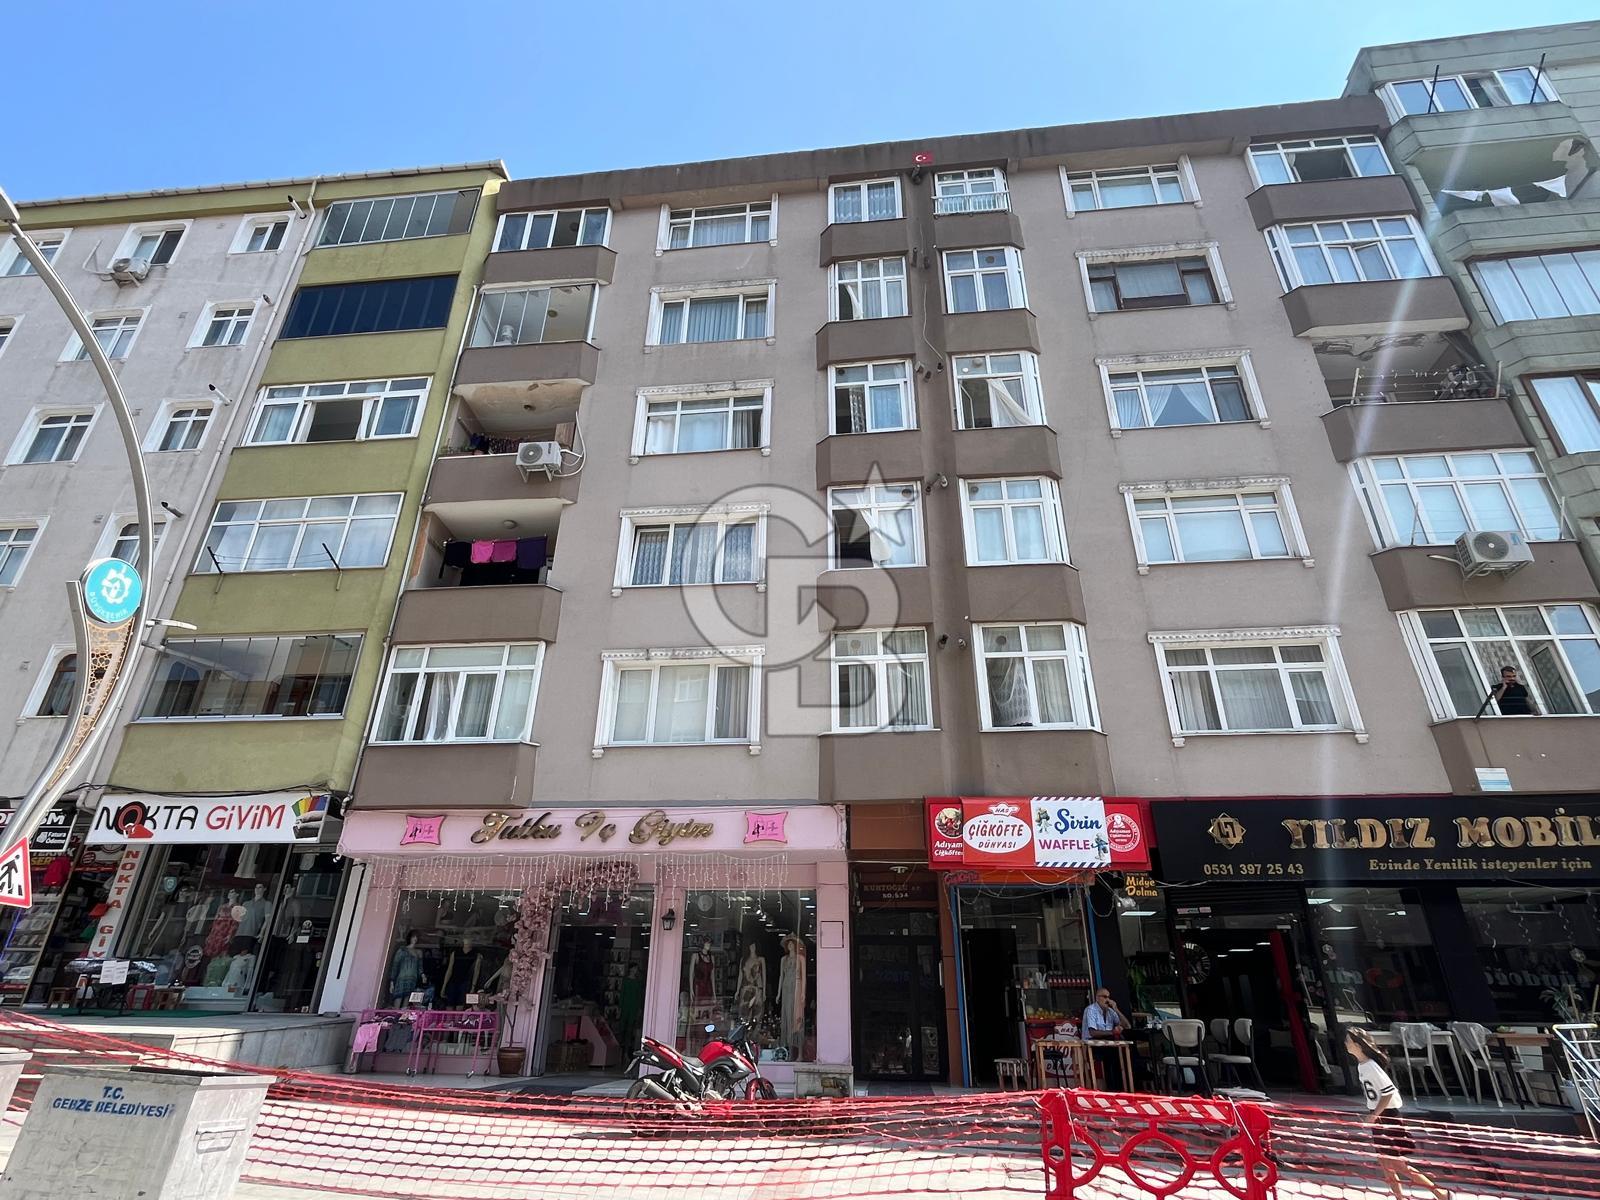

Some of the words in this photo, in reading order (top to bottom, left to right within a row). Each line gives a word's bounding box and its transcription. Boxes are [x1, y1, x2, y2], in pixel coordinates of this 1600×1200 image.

[94, 801, 199, 834] NOKTA
[1054, 808, 1102, 834] Şirin
[968, 820, 1024, 840] ÇİĞKÖFTE
[1281, 817, 1436, 849] YILDIZ
[1453, 807, 1600, 848] MOBİL
[934, 841, 963, 850] Adıyam
[978, 840, 1017, 849] DÜNYASI
[1038, 839, 1091, 850] WAFFLE
[1203, 864, 1234, 875] 0531
[1239, 864, 1262, 875] 397
[1267, 864, 1284, 875] 25
[1287, 864, 1304, 874] 43
[1369, 859, 1420, 870] Evinde
[1424, 858, 1478, 870] Yenilik
[1481, 858, 1558, 872] isteyenler
[1562, 857, 1592, 872] için
[1125, 886, 1158, 897] Dolma
[102, 1086, 124, 1100] T.C.
[1364, 1080, 1377, 1101] 6
[52, 1098, 93, 1112] GEBZE
[94, 1101, 170, 1118] BELEDİYESİ
